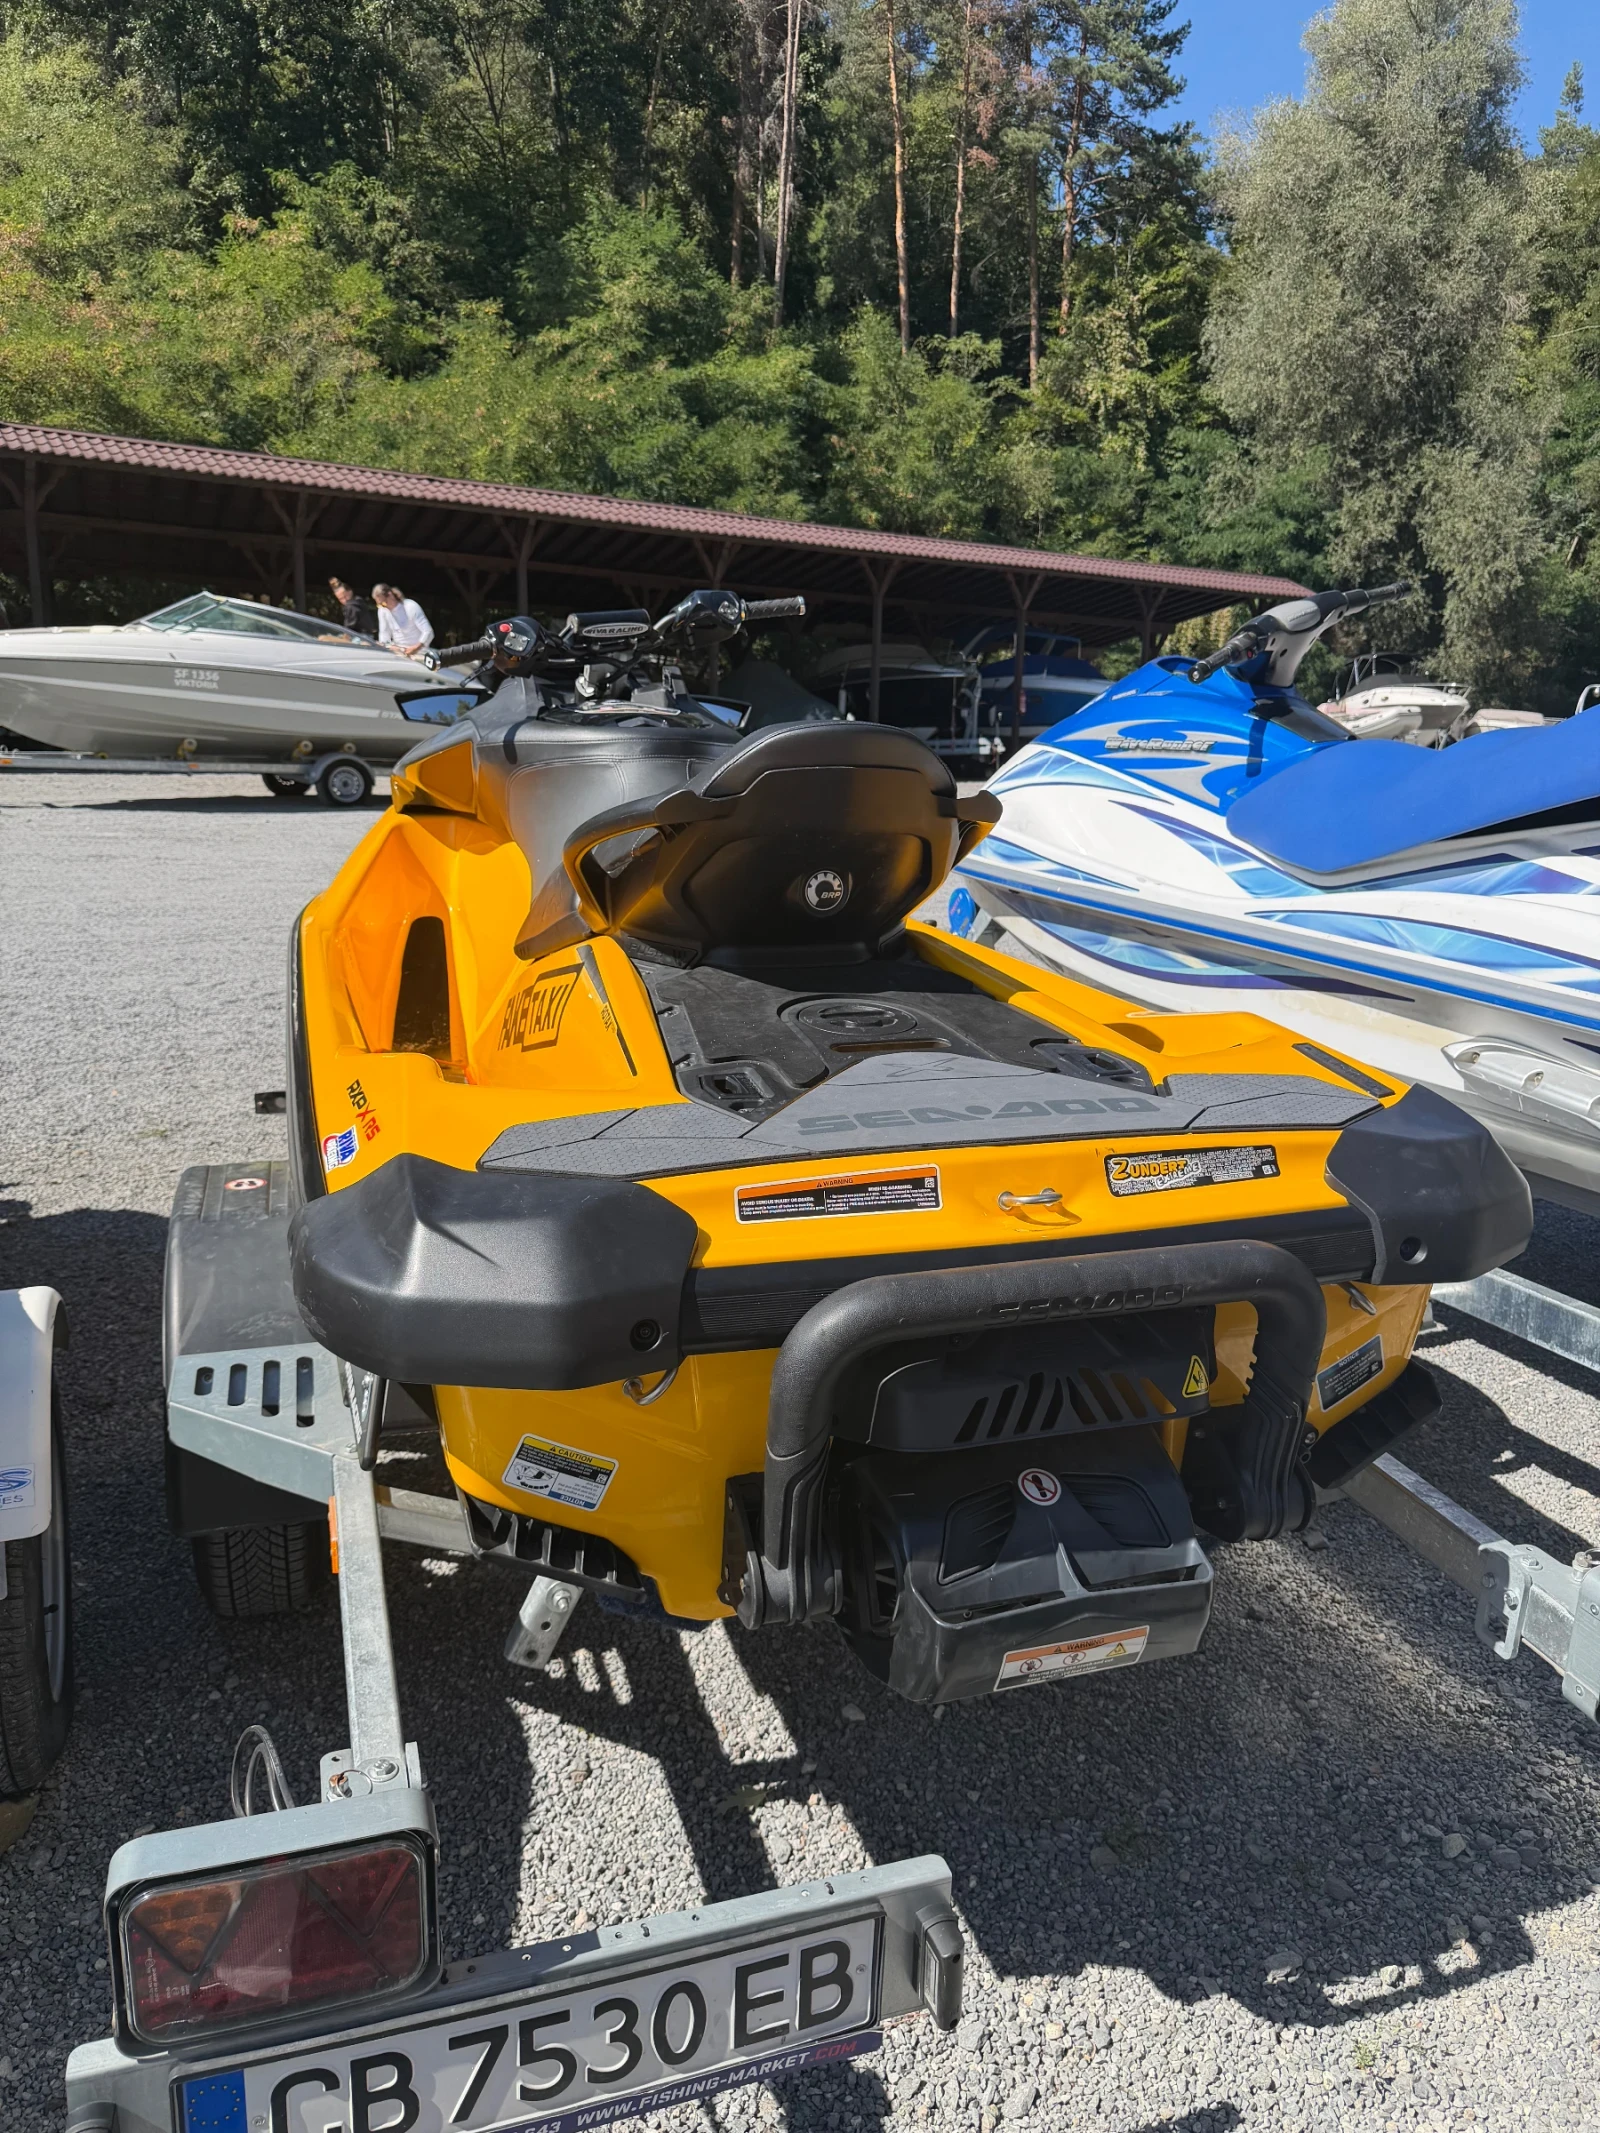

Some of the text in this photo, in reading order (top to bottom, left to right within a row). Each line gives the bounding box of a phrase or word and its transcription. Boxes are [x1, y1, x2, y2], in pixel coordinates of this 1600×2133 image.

[174, 668, 219, 681] SF 1356
[174, 679, 219, 689] VIKTORIA
[821, 891, 841, 899] BRP
[338, 1129, 356, 1162] RIVA
[1112, 1159, 1188, 1180] ZUNDERT
[823, 1178, 854, 1187] WARNING
[1338, 1351, 1360, 1367] NOTICE
[558, 1445, 593, 1463] CAUTION
[560, 1495, 585, 1506] NOTICE
[1066, 1637, 1105, 1651] WARNING
[270, 1940, 854, 2133] CB 7530 EB
[577, 2041, 857, 2127] WWW.FISHING-MARKET.COM
